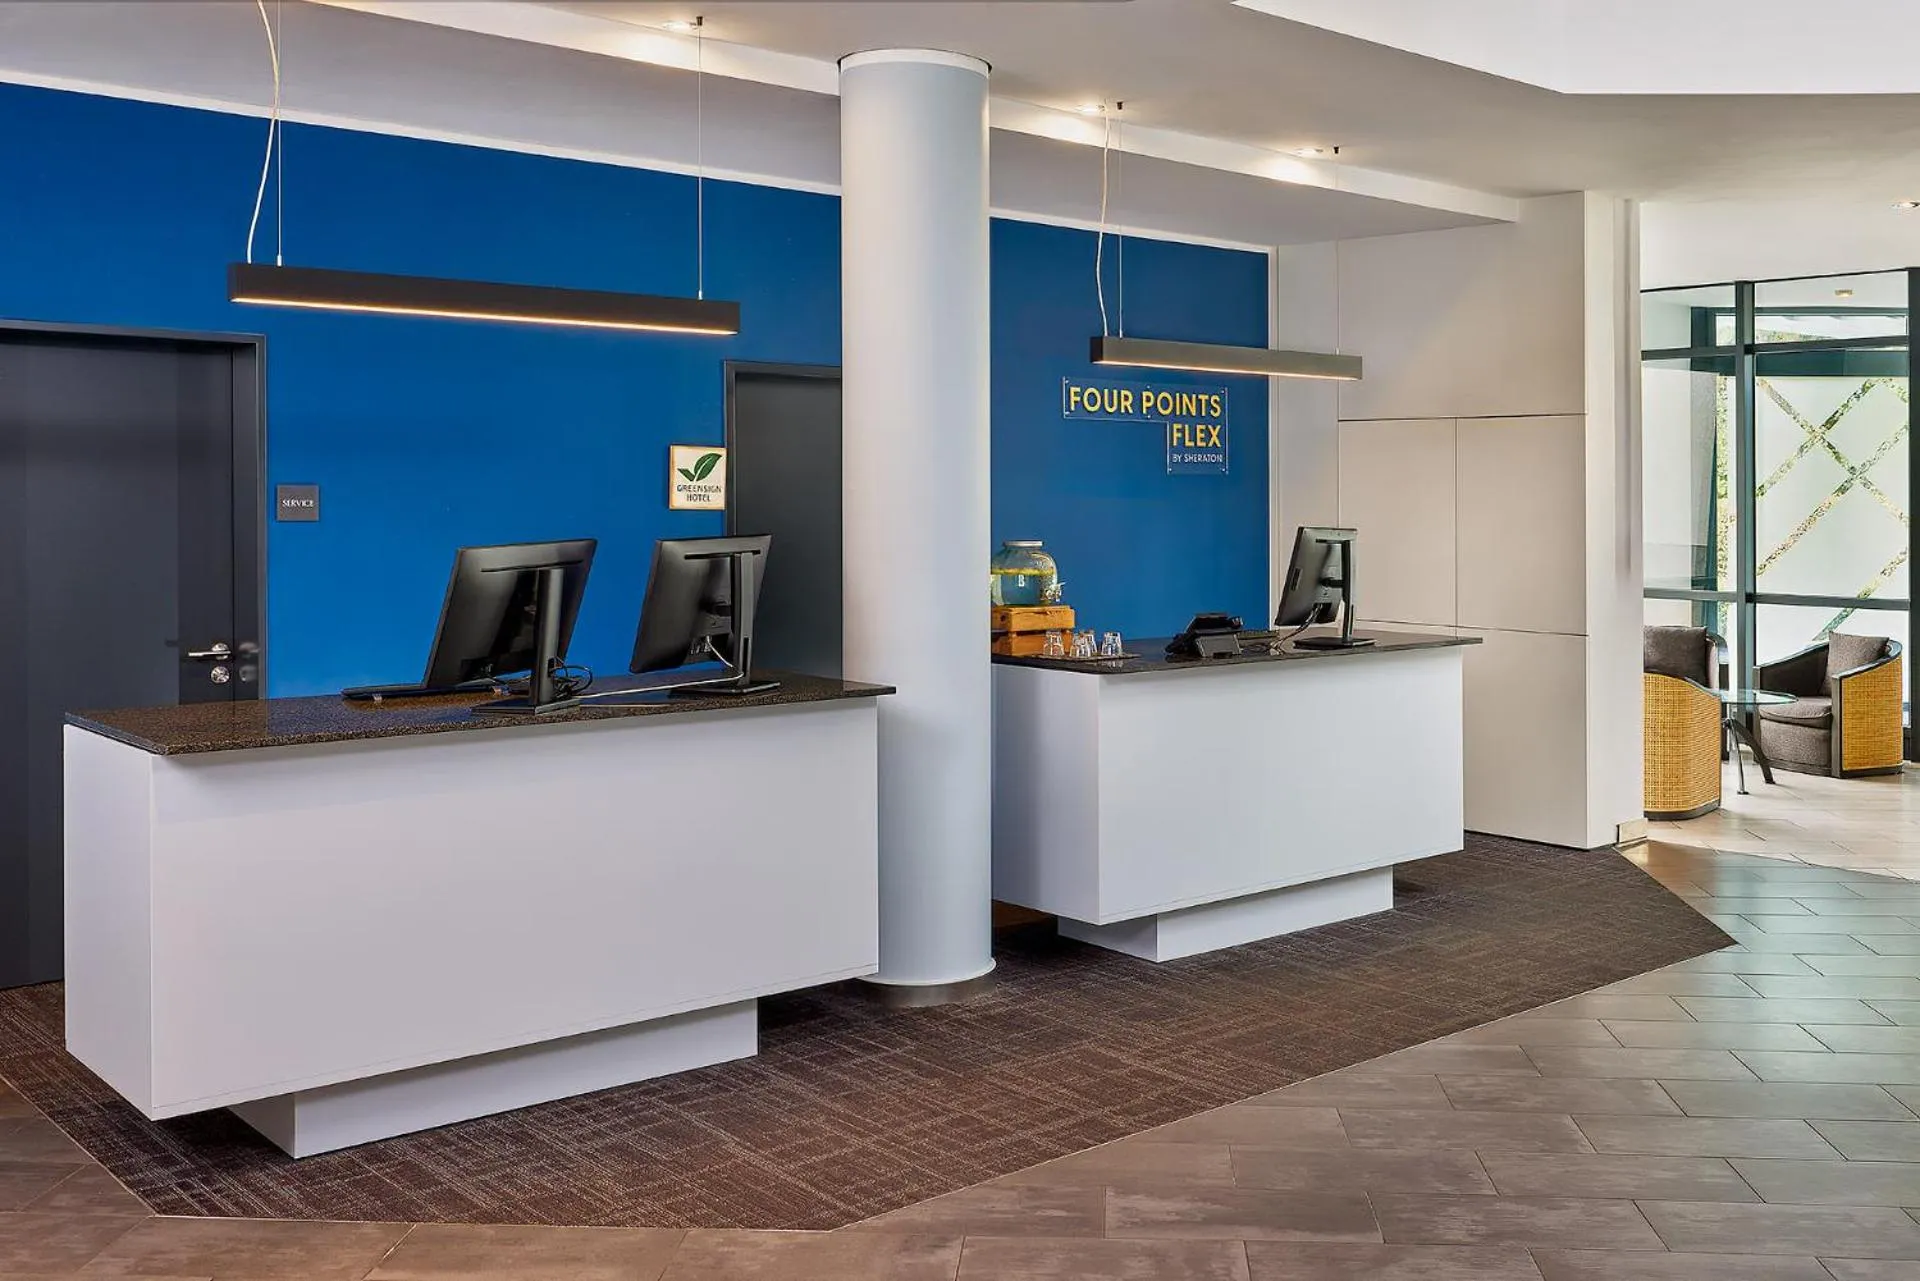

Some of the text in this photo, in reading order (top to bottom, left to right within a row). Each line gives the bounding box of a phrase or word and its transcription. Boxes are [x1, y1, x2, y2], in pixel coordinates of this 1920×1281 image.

[1069, 386, 1222, 418] FOUR POINTS
[1172, 423, 1221, 448] FLEX
[1172, 453, 1223, 463] BY SHERATON
[677, 484, 722, 493] GREENSIGN
[686, 493, 711, 502] HOTEL
[282, 499, 314, 508] SERVICE
